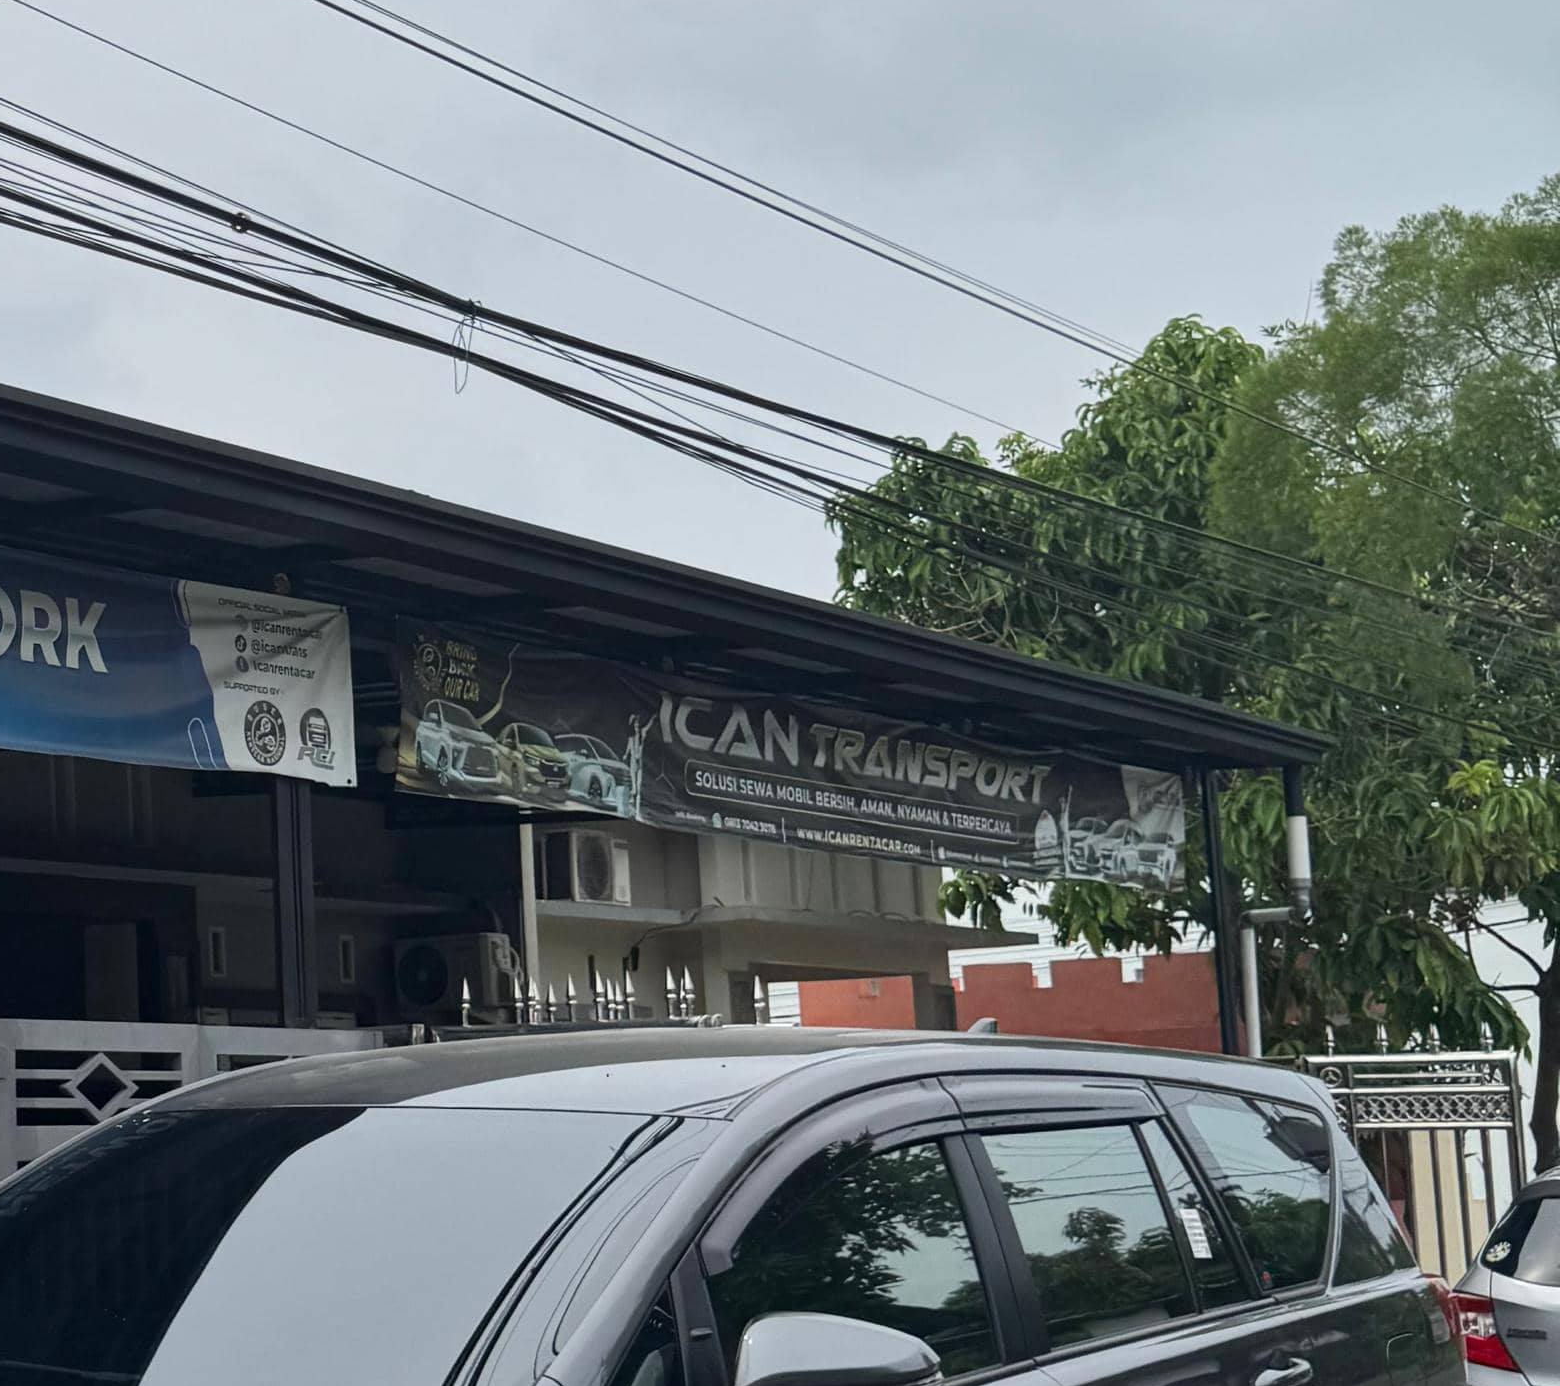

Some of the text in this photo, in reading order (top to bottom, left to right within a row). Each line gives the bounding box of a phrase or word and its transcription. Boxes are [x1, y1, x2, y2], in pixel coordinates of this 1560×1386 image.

[658, 691, 1053, 805] ICAN TRANSPORT
[695, 770, 738, 792] SOLUSI
[739, 779, 774, 799] SEWA
[776, 785, 813, 805] MOBIL
[897, 804, 940, 825] NYAMAN
[950, 813, 1013, 835] TERPERCAYA
